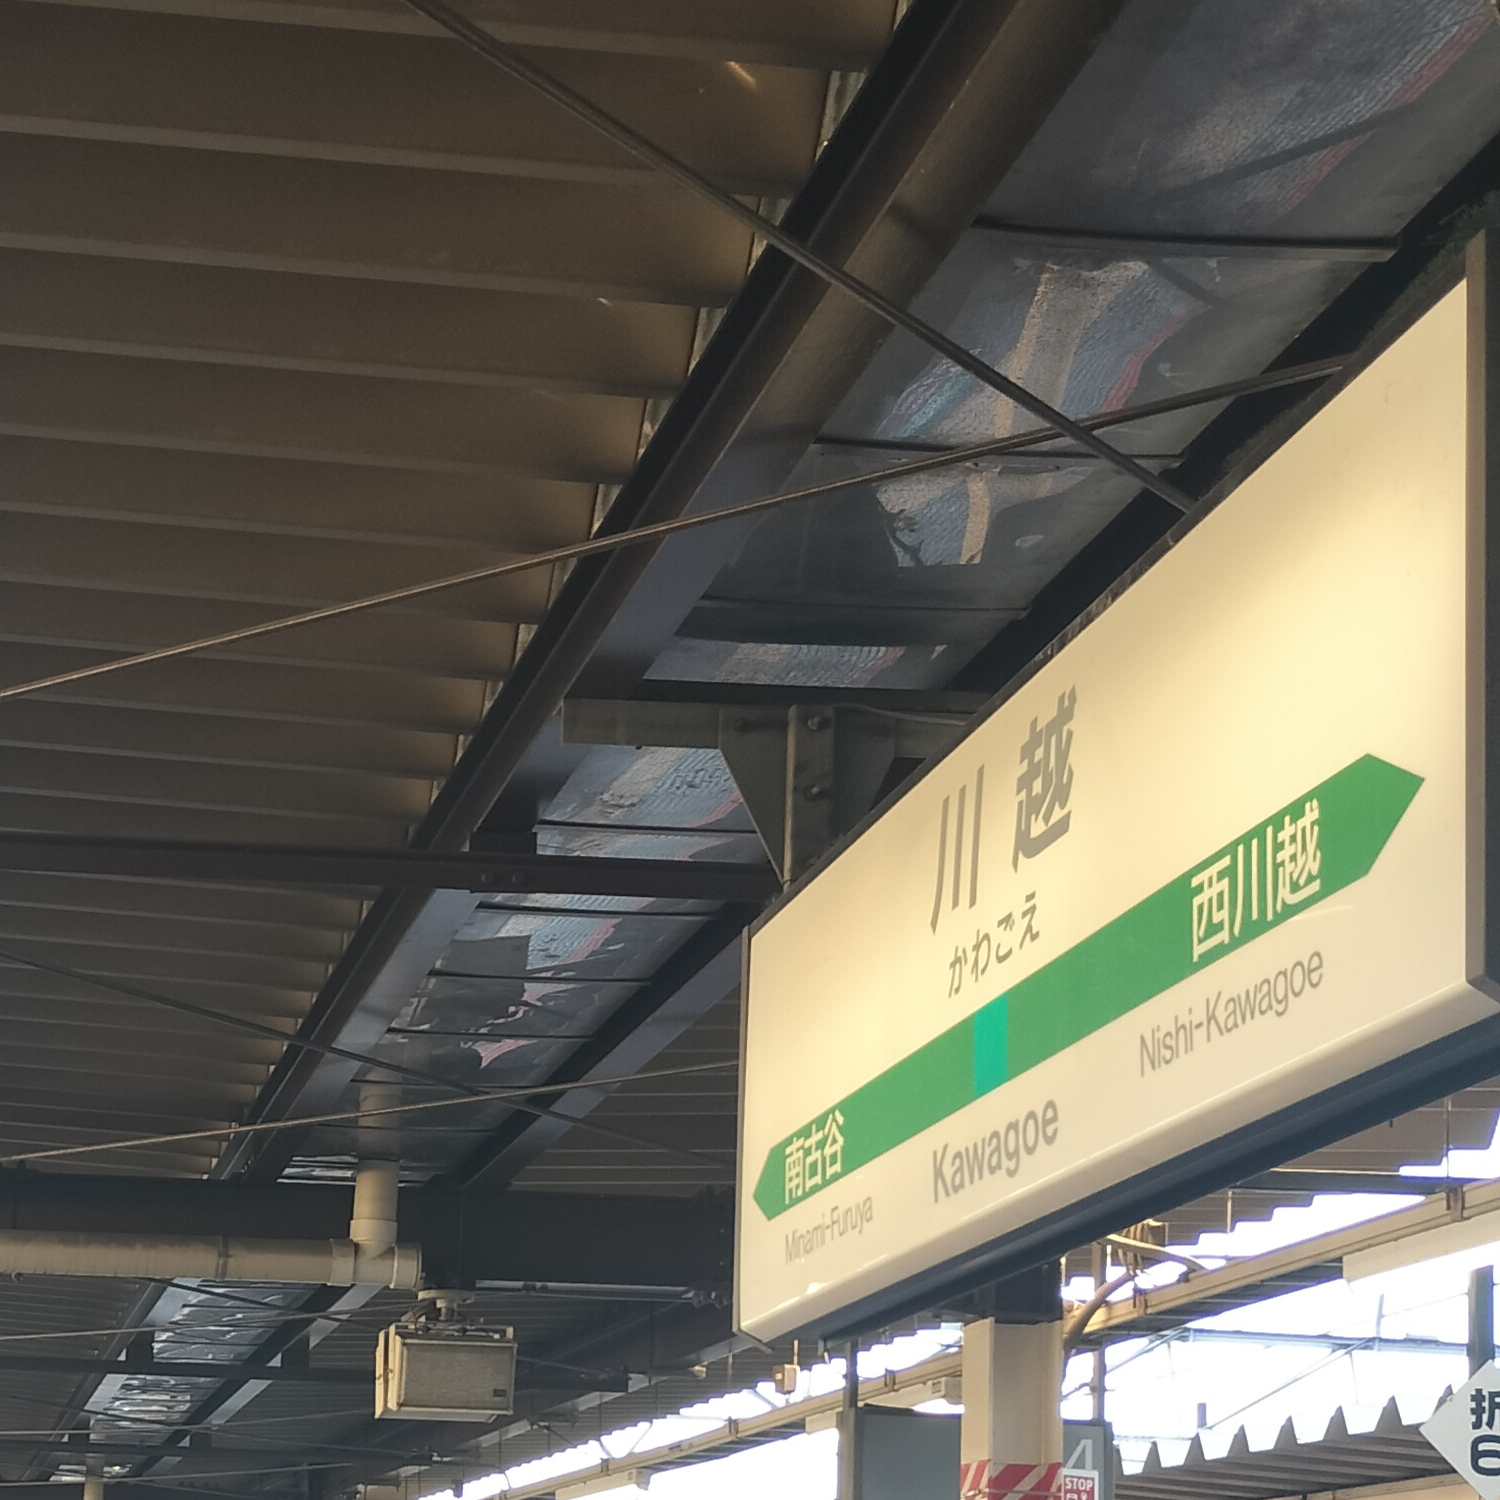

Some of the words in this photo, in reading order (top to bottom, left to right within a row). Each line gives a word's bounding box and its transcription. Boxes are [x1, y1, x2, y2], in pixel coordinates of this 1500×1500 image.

[931, 684, 1077, 936] 川越
[1190, 797, 1322, 963] 西川越
[948, 890, 1041, 998] かわごえ
[1139, 949, 1325, 1078] Nishi-Kawagoe
[784, 1109, 845, 1205] 南古谷
[932, 1098, 1060, 1204] Kawagoe
[784, 1193, 875, 1265] Minami-Furuya
[1064, 1477, 1094, 1491] STOP
